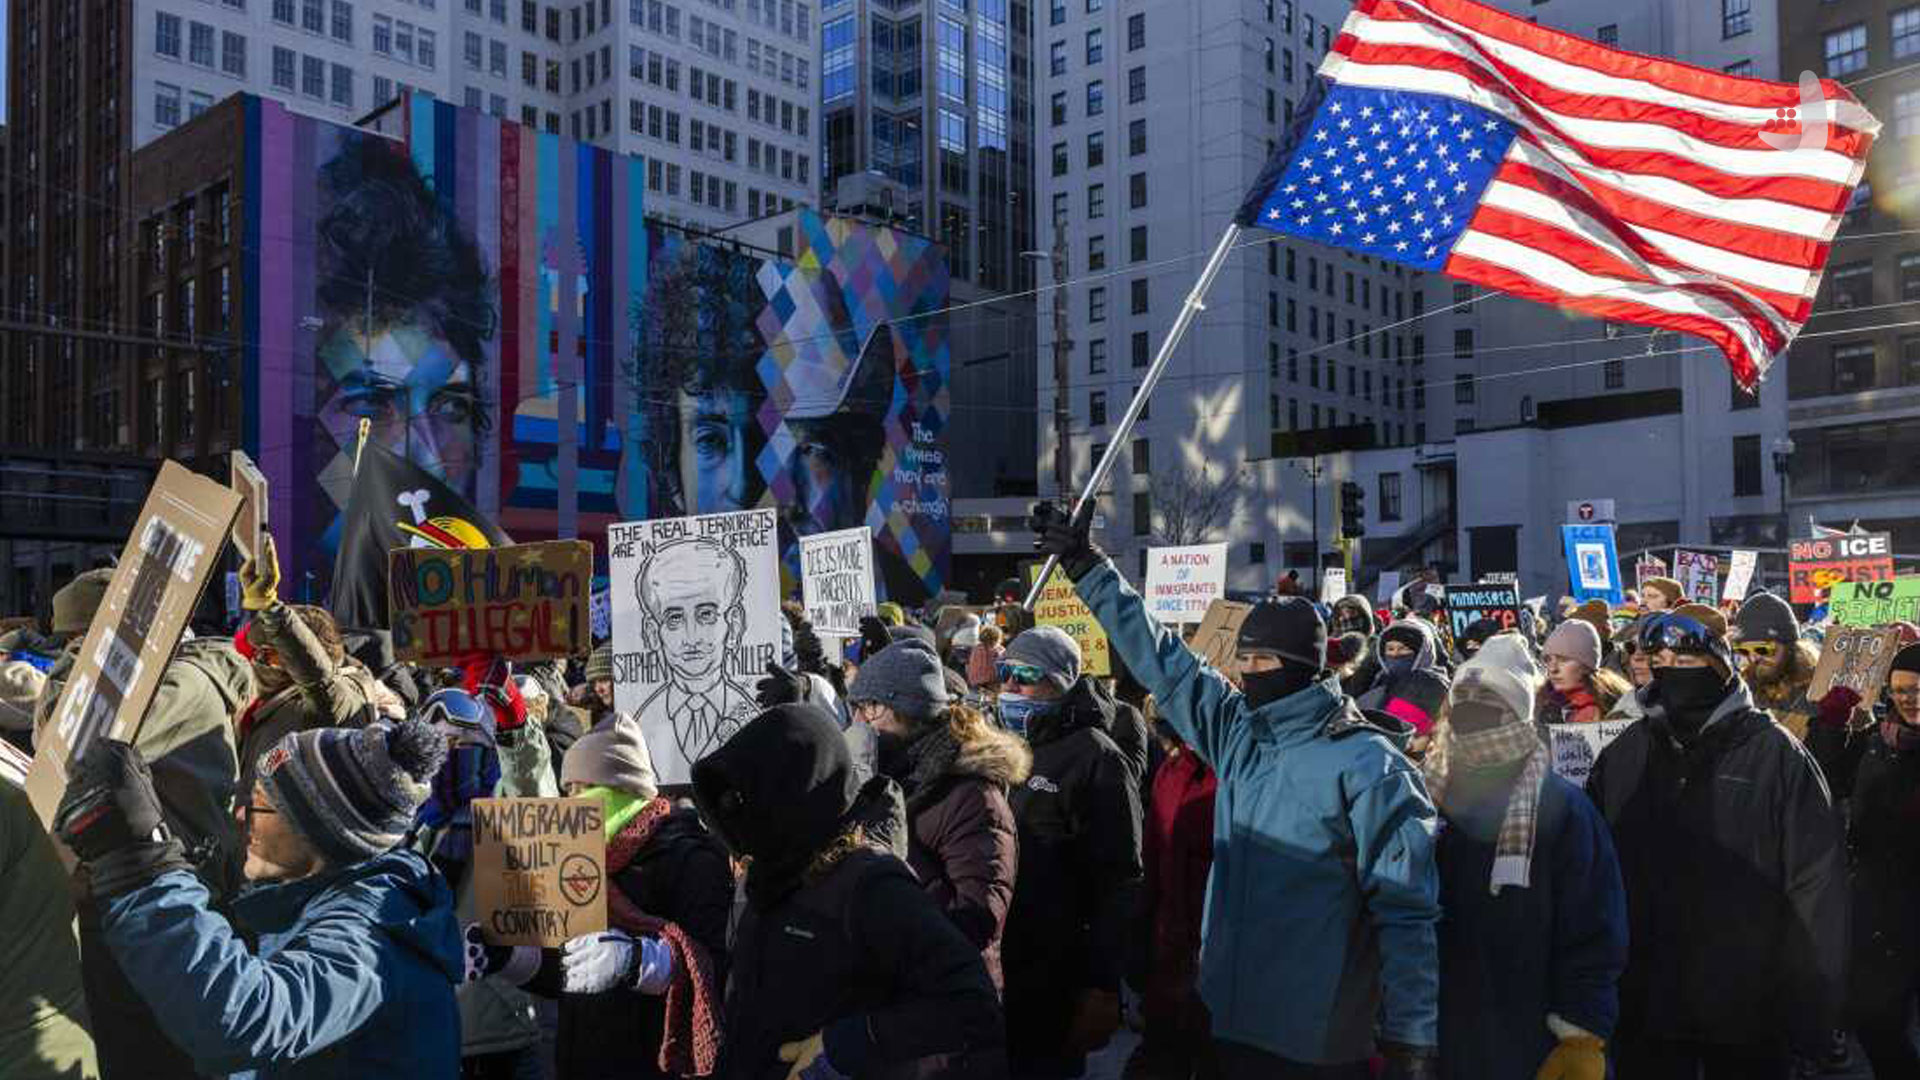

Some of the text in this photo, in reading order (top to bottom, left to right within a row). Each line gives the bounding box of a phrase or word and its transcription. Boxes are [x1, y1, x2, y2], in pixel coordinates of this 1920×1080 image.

[611, 511, 774, 542] THE REAL TERRORISTS
[611, 529, 769, 558] ARE IN OFFICE
[1791, 537, 1888, 559] NO ICE
[1161, 553, 1211, 566] A NATION
[1677, 551, 1718, 573] BAD
[1794, 564, 1890, 587] RIST
[1852, 582, 1895, 600] NO
[613, 650, 668, 685] STEPHEN
[473, 803, 600, 845] IMMIGRANTS
[505, 842, 560, 871] BUILT
[491, 909, 569, 937] COUNTRY
